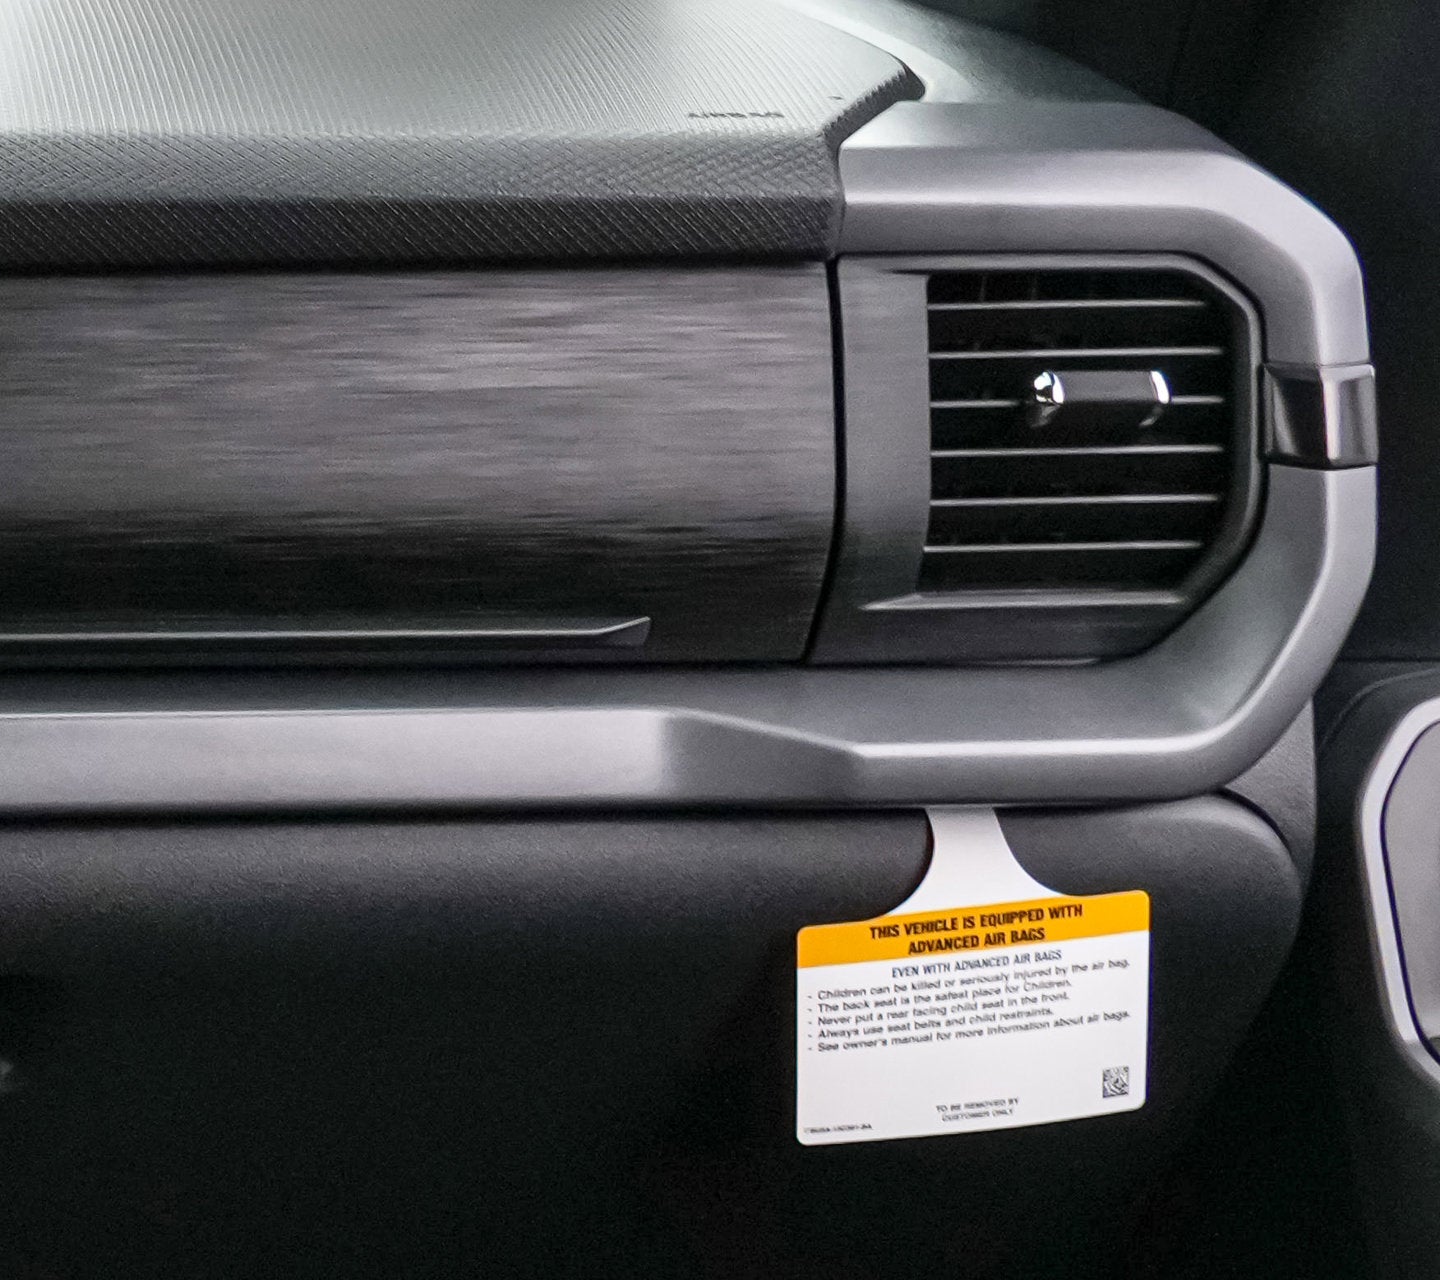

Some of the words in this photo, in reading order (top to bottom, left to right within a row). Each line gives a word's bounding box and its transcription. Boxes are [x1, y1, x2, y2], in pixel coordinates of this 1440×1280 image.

[870, 925, 900, 940] THIS
[903, 918, 958, 935] VEHICLE
[962, 916, 975, 929] IS
[980, 908, 1044, 929] EQUIPPED
[1048, 904, 1083, 919] WITH
[908, 937, 979, 955] ADVANCED
[984, 933, 1007, 948] AIR
[1011, 928, 1045, 943] BAGS
[892, 966, 919, 978] EVEN
[923, 962, 951, 975] WITH
[954, 956, 1010, 972] ADVANCED
[1014, 953, 1030, 965] AIR
[1034, 950, 1062, 962] BAGS
[818, 988, 866, 1000] Children
[870, 986, 889, 995] can
[894, 983, 908, 993] be
[912, 980, 940, 991] killed
[945, 979, 955, 987] or
[960, 973, 1009, 986] seriously
[1014, 967, 1051, 979] injured
[1055, 966, 1067, 975] by
[1072, 963, 1088, 973] the
[818, 1003, 839, 1012] The
[843, 1000, 870, 1011] back
[914, 994, 931, 1003] the
[818, 1015, 851, 1026] Never
[856, 1012, 873, 1025] put
[818, 1027, 859, 1040] Always
[818, 1042, 839, 1052] See
